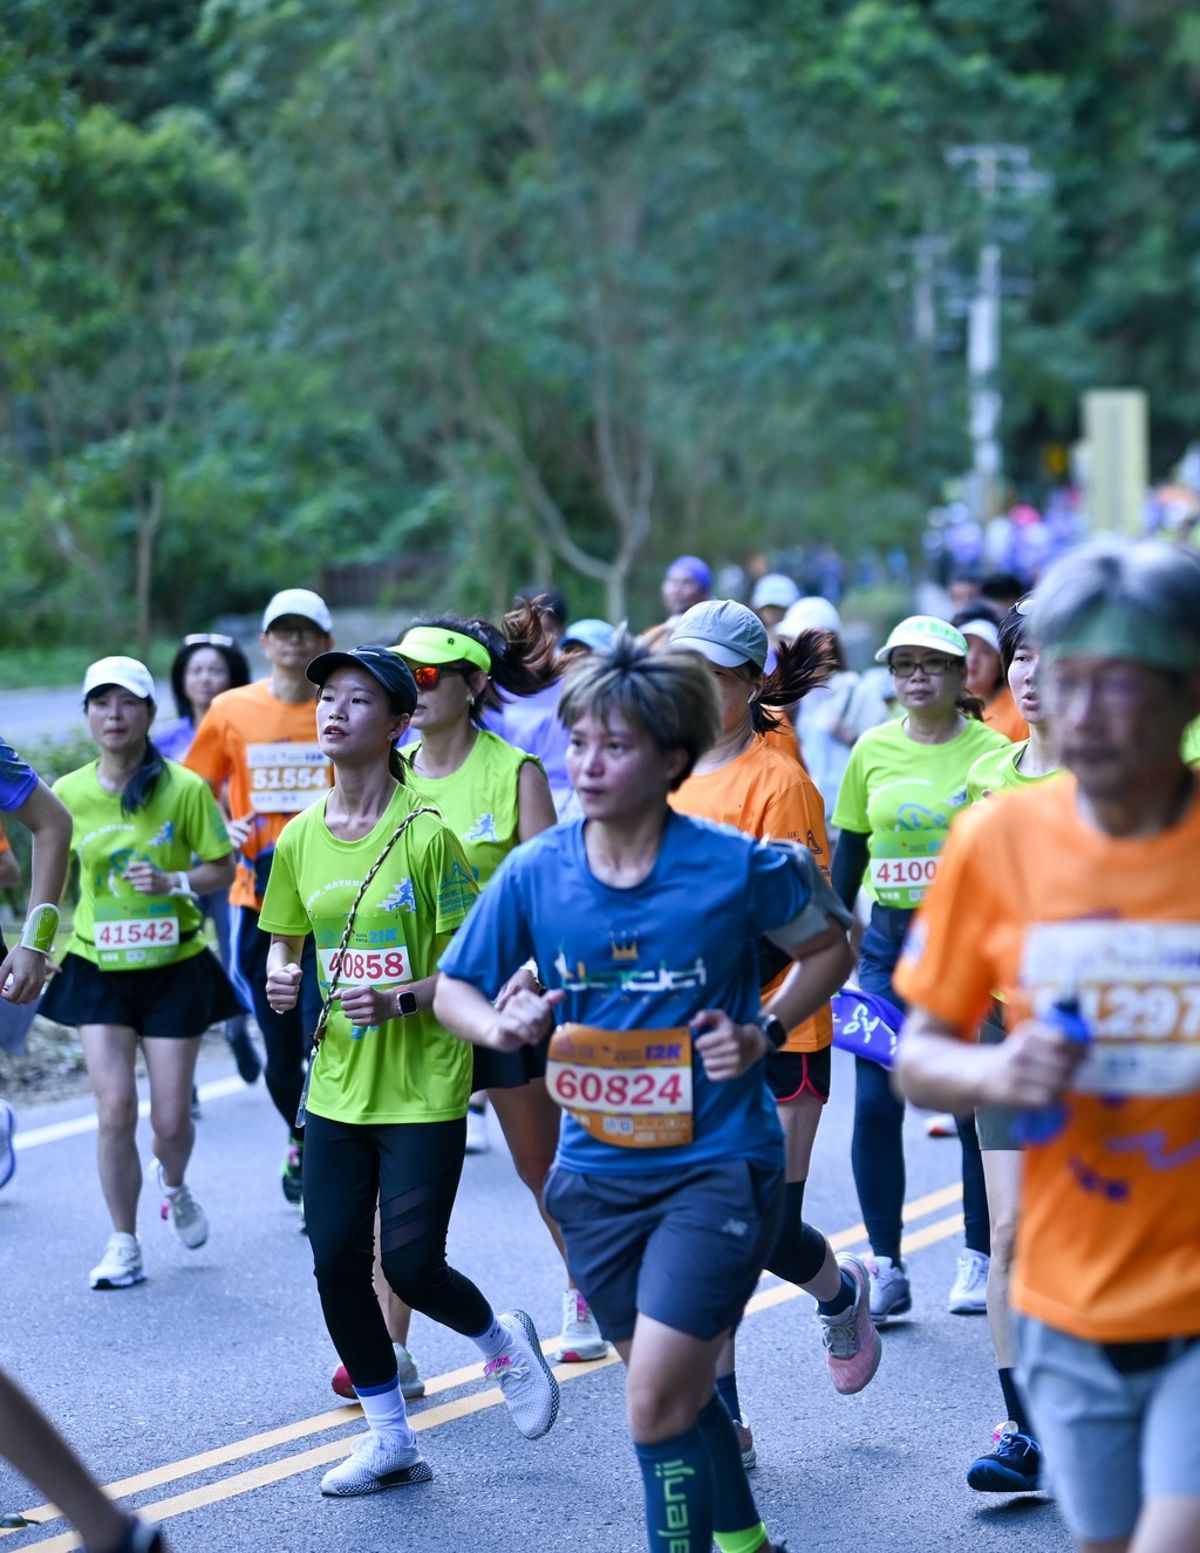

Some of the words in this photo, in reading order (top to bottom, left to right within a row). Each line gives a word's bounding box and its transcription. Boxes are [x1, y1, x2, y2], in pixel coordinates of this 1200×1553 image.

[252, 768, 326, 789] 51554
[100, 922, 174, 944] 41542
[329, 952, 404, 980] 40858
[556, 1069, 682, 1105] 60824
